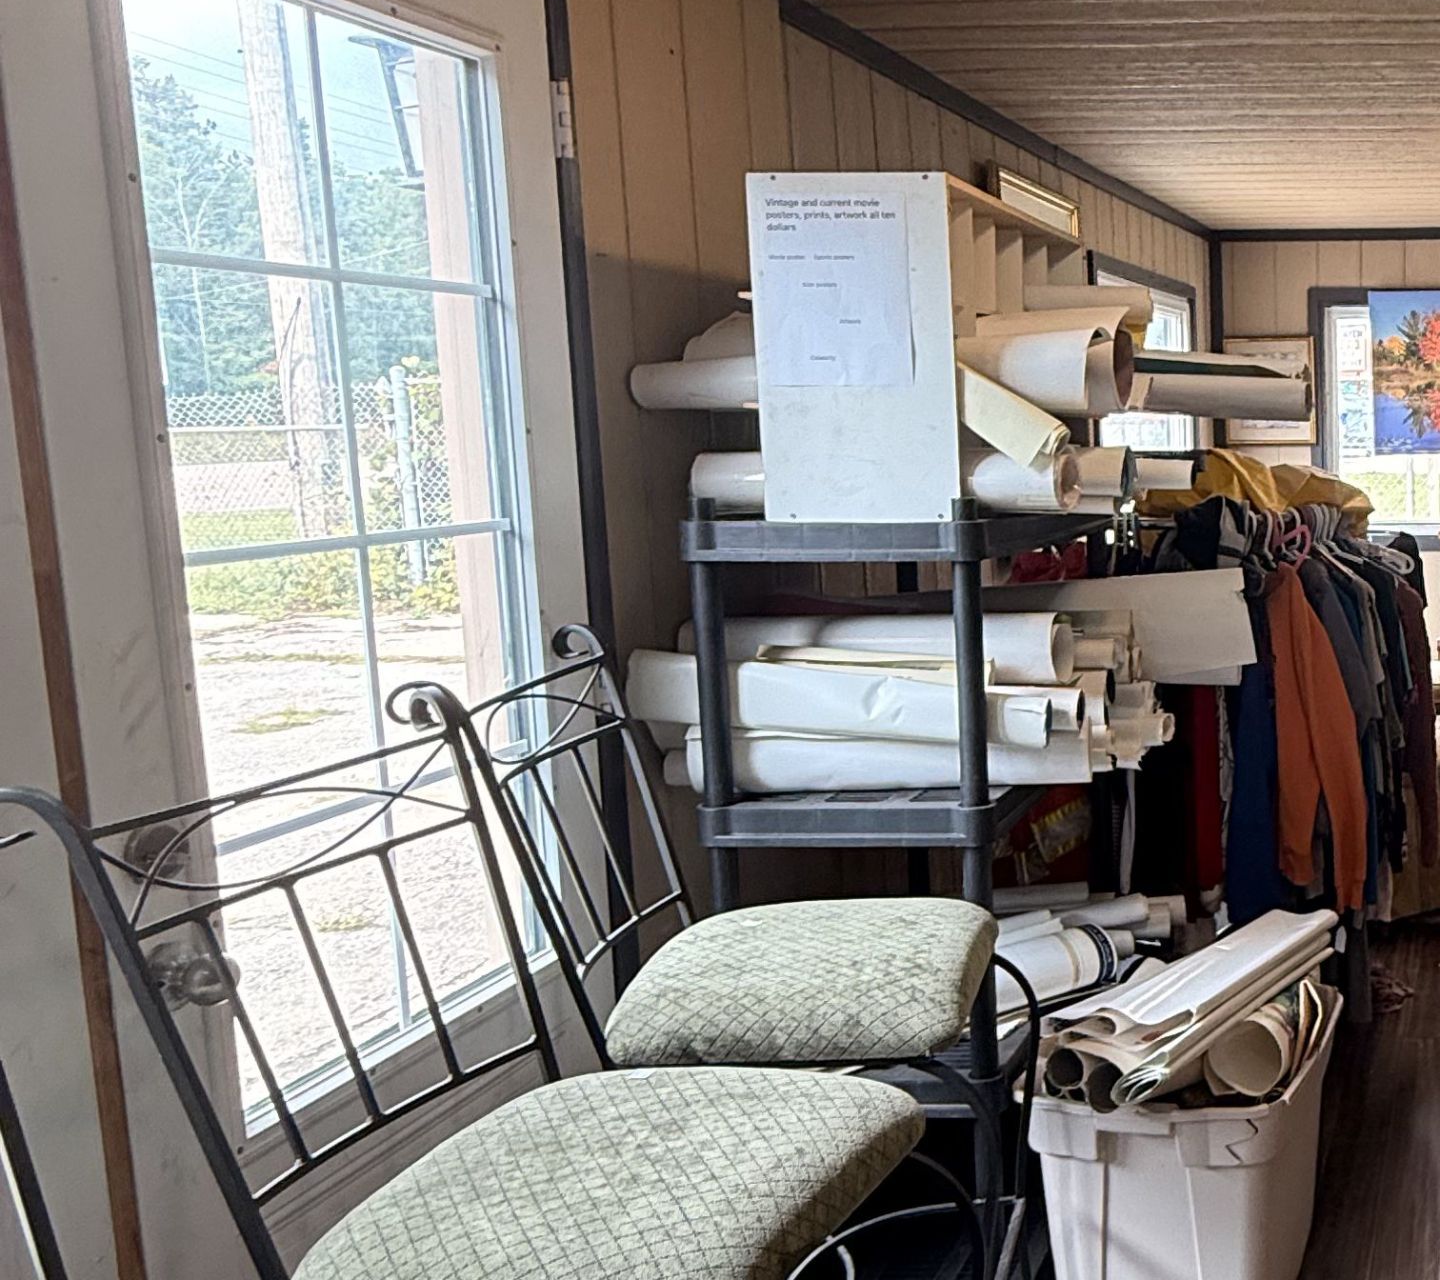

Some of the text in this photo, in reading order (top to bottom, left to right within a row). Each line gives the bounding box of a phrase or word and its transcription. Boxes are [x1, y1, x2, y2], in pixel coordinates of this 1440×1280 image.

[765, 198, 880, 208] Vintage and current movie
[765, 211, 896, 221] posters, prints, artwork all ten
[766, 223, 797, 231] dollars
